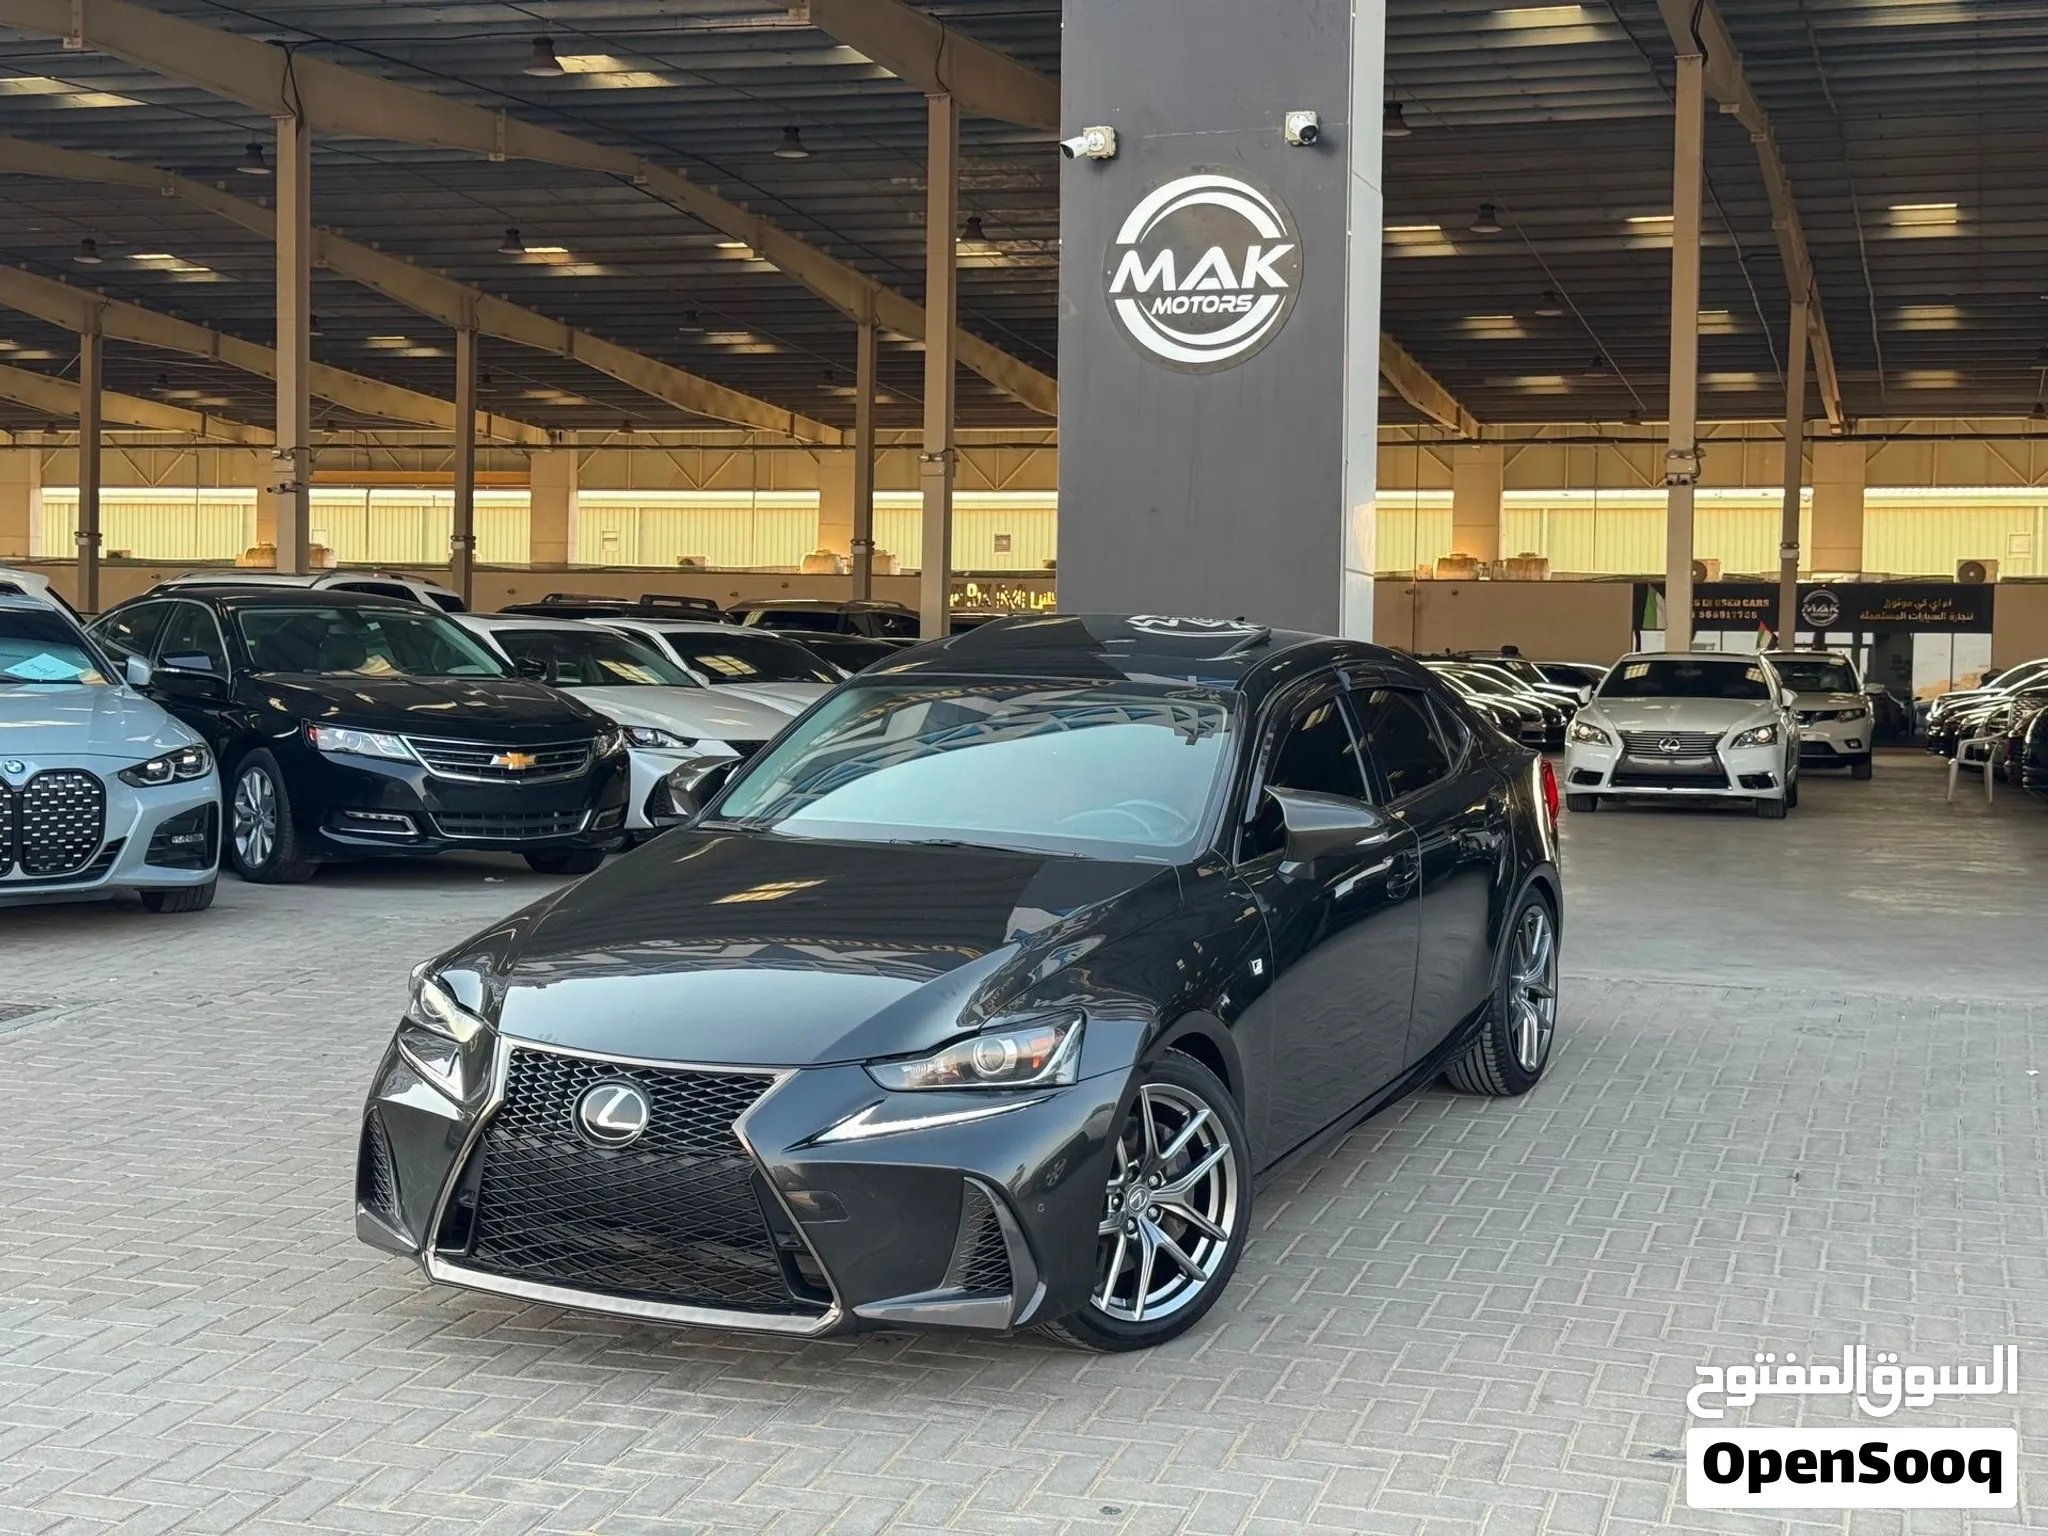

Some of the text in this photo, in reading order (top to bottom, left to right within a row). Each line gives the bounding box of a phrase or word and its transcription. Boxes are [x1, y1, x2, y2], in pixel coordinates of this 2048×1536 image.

[1108, 244, 1296, 293] MAK
[1151, 294, 1254, 315] MOTORS
[1715, 599, 1741, 607] USED
[1742, 599, 1770, 607] CARS
[1801, 604, 1840, 613] MAK
